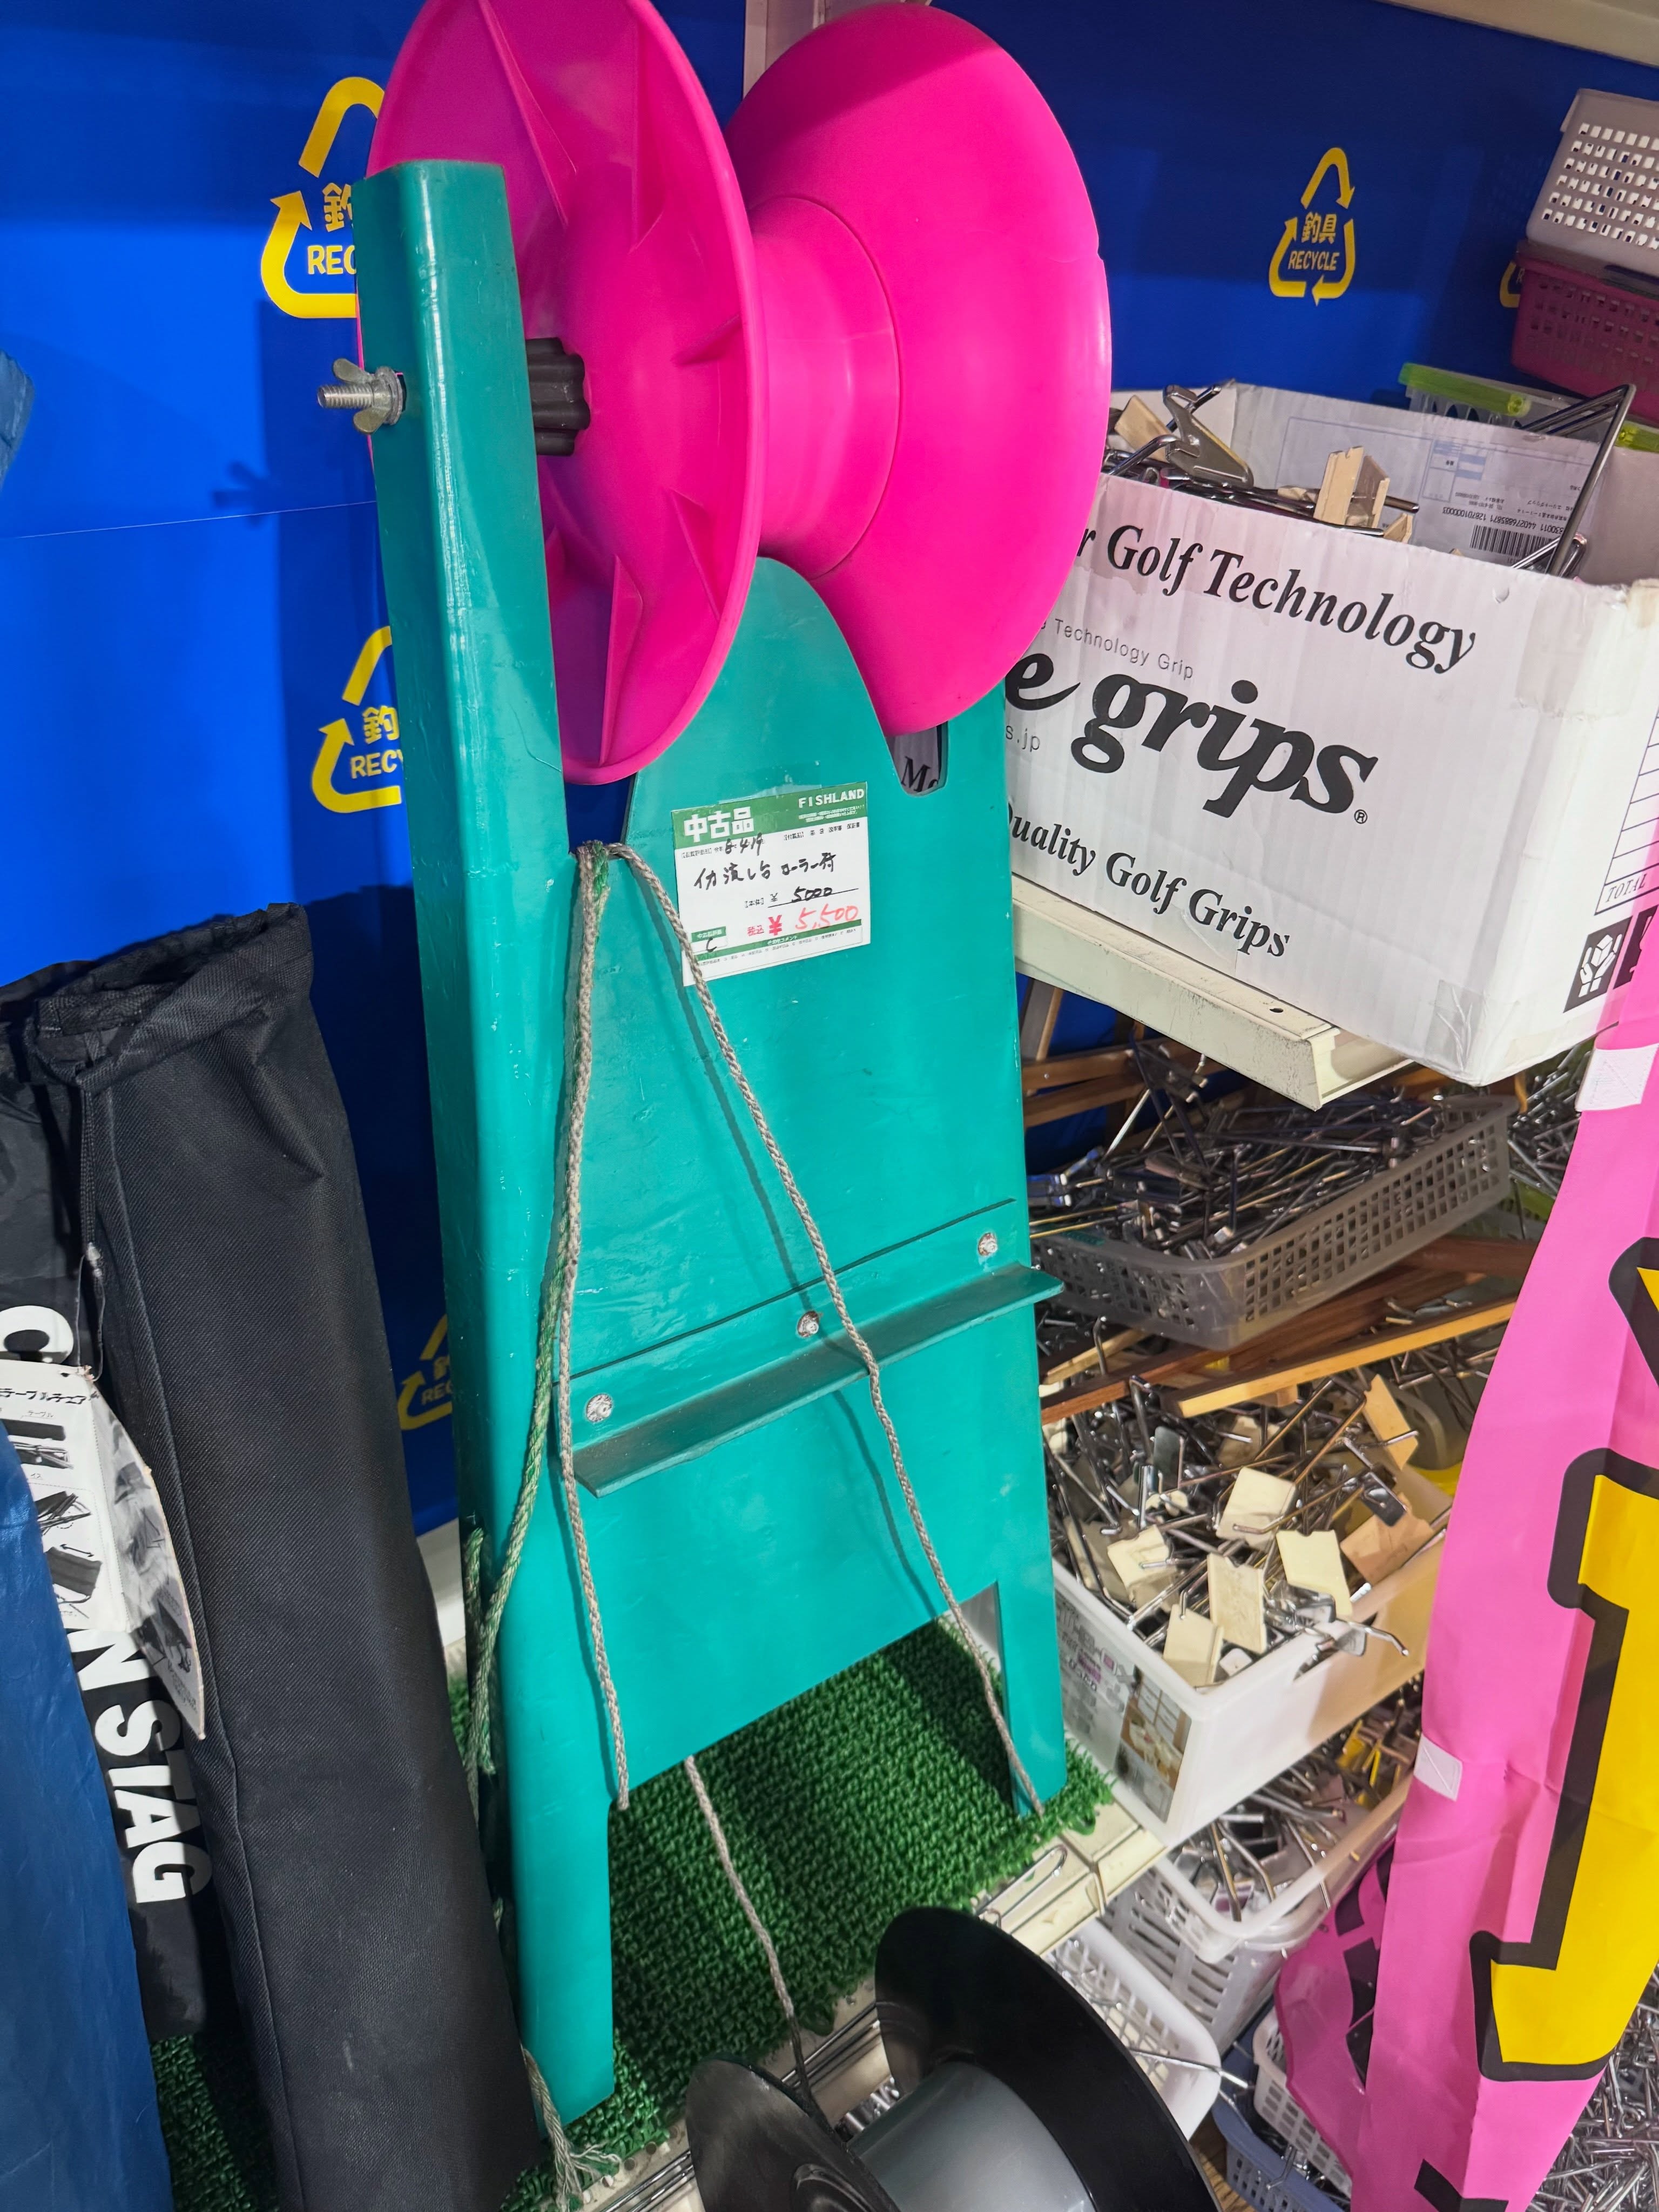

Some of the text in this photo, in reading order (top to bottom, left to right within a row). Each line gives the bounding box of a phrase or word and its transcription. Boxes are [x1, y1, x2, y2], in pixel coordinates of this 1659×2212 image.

[1301, 212, 1337, 244] 釣具
[1288, 251, 1339, 271] RECYCLE
[1107, 525, 1203, 596] Golf
[1204, 549, 1476, 674] Technology
[1055, 618, 1193, 680] Technology Grip
[362, 705, 400, 744] 釣
[1006, 725, 1041, 752] s.jp
[1071, 673, 1379, 818] grips
[798, 788, 865, 808] FISHLAND
[683, 806, 754, 843] 中古品
[791, 886, 833, 903] 5000
[1008, 802, 1290, 957] uality Golf Grips
[1606, 874, 1647, 902] TOTAL
[768, 914, 783, 936] ¥
[794, 903, 860, 930] 5,500
[95, 1700, 213, 1903] STAG
